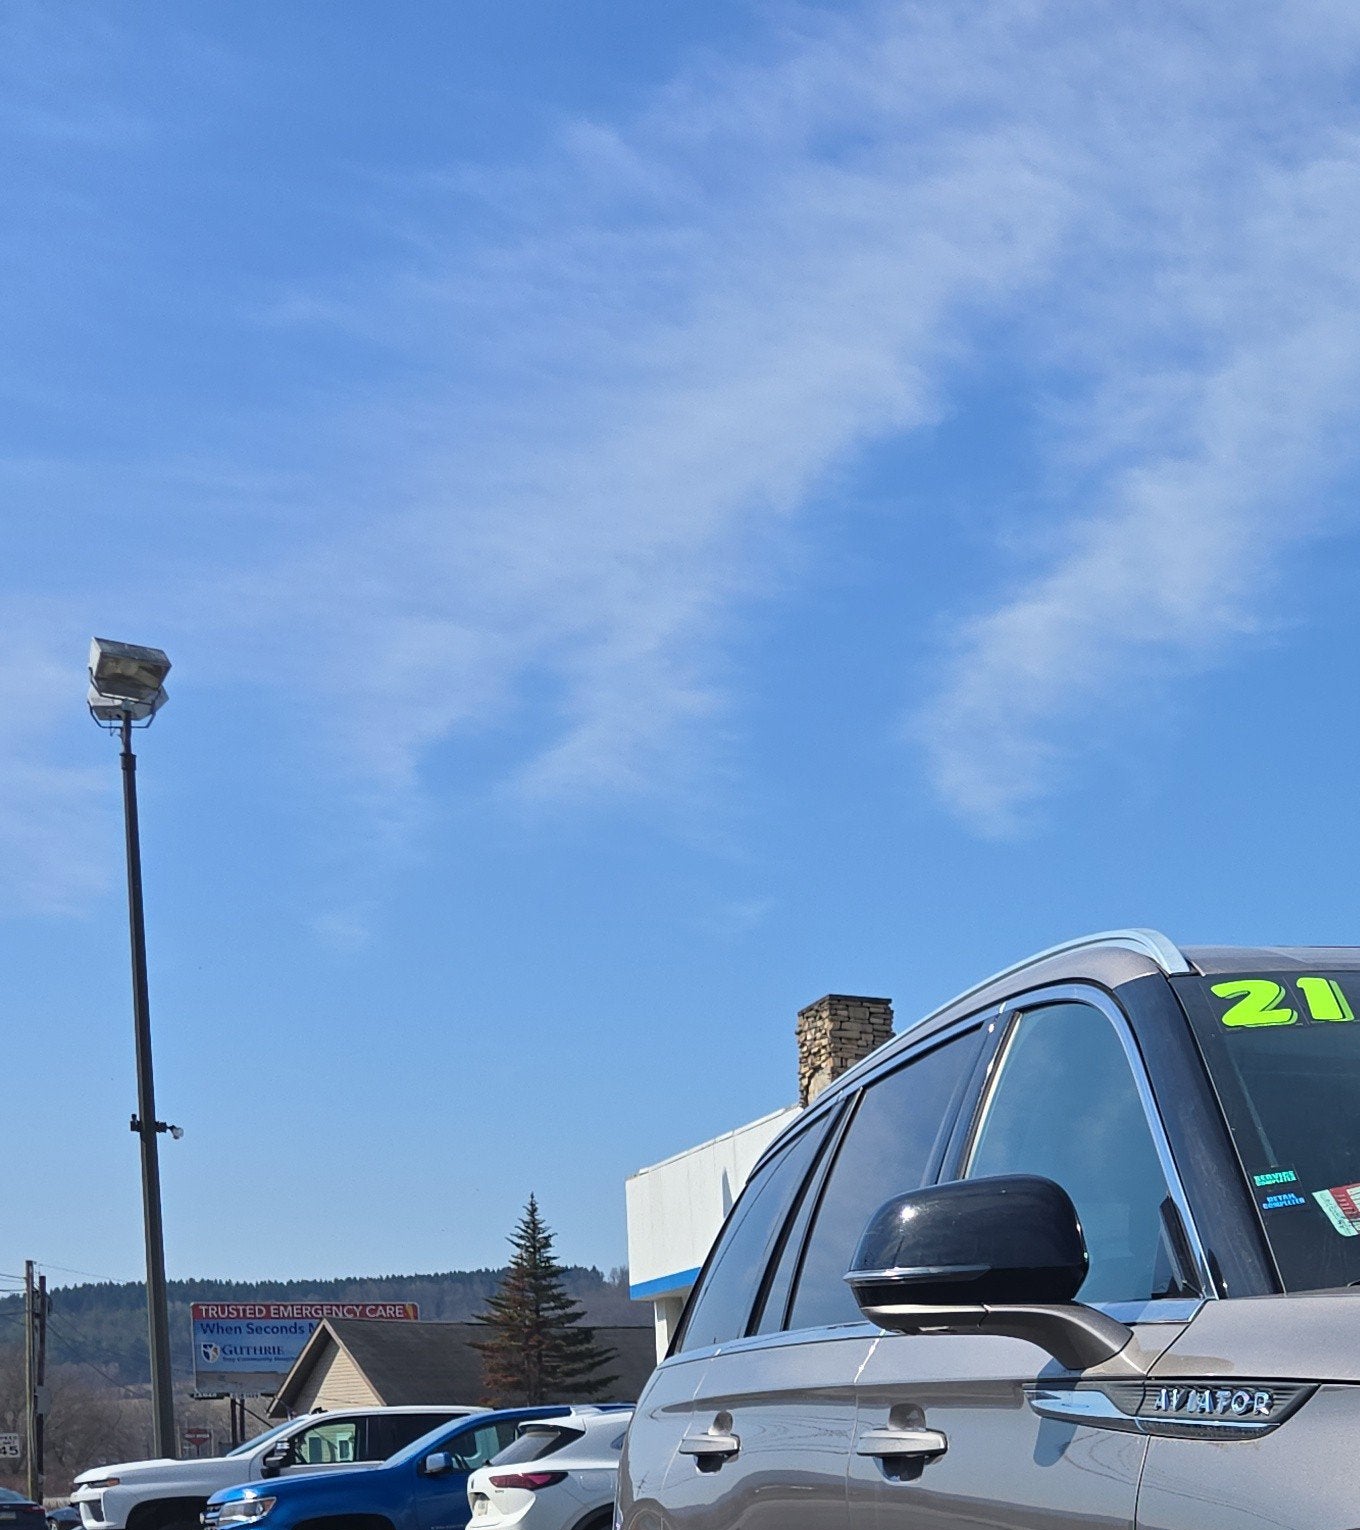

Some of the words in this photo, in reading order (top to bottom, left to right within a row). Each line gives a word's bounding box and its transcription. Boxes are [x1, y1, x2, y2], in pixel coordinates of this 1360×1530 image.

[1210, 977, 1355, 1027] 21
[199, 1305, 266, 1318] TRUSTED
[270, 1305, 363, 1318] EMERGENCY
[365, 1305, 404, 1318] CARE
[200, 1322, 243, 1335] When
[246, 1322, 305, 1335] Seconds
[1154, 1387, 1273, 1416] AVIATOR
